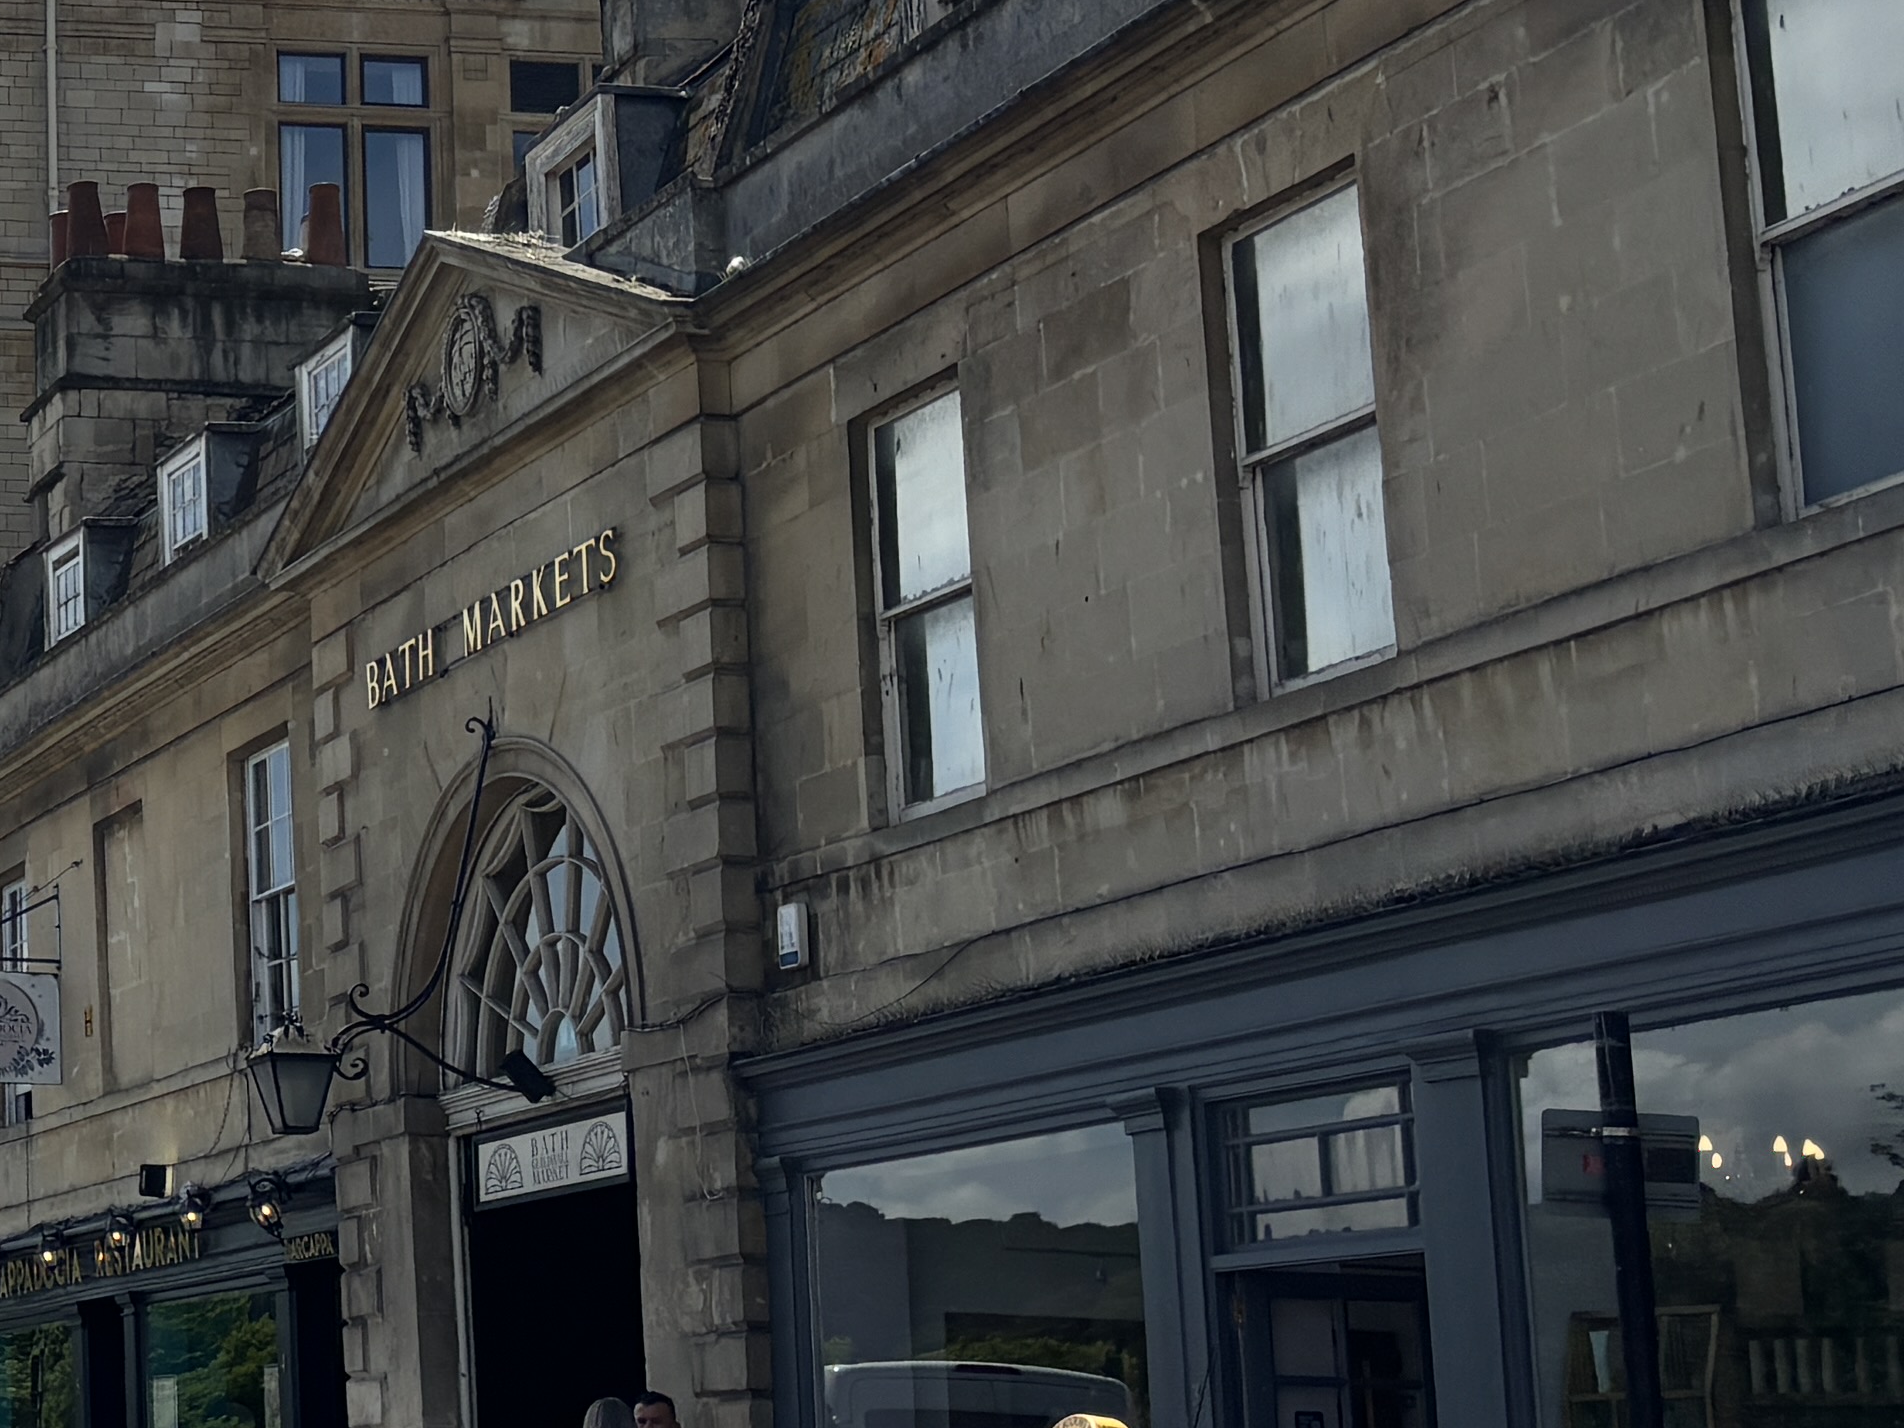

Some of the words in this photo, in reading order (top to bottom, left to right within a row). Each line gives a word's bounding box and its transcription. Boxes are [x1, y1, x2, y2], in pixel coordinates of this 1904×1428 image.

[366, 628, 433, 710] BATH
[462, 529, 616, 657] MARKETS
[530, 1129, 569, 1157] BATH
